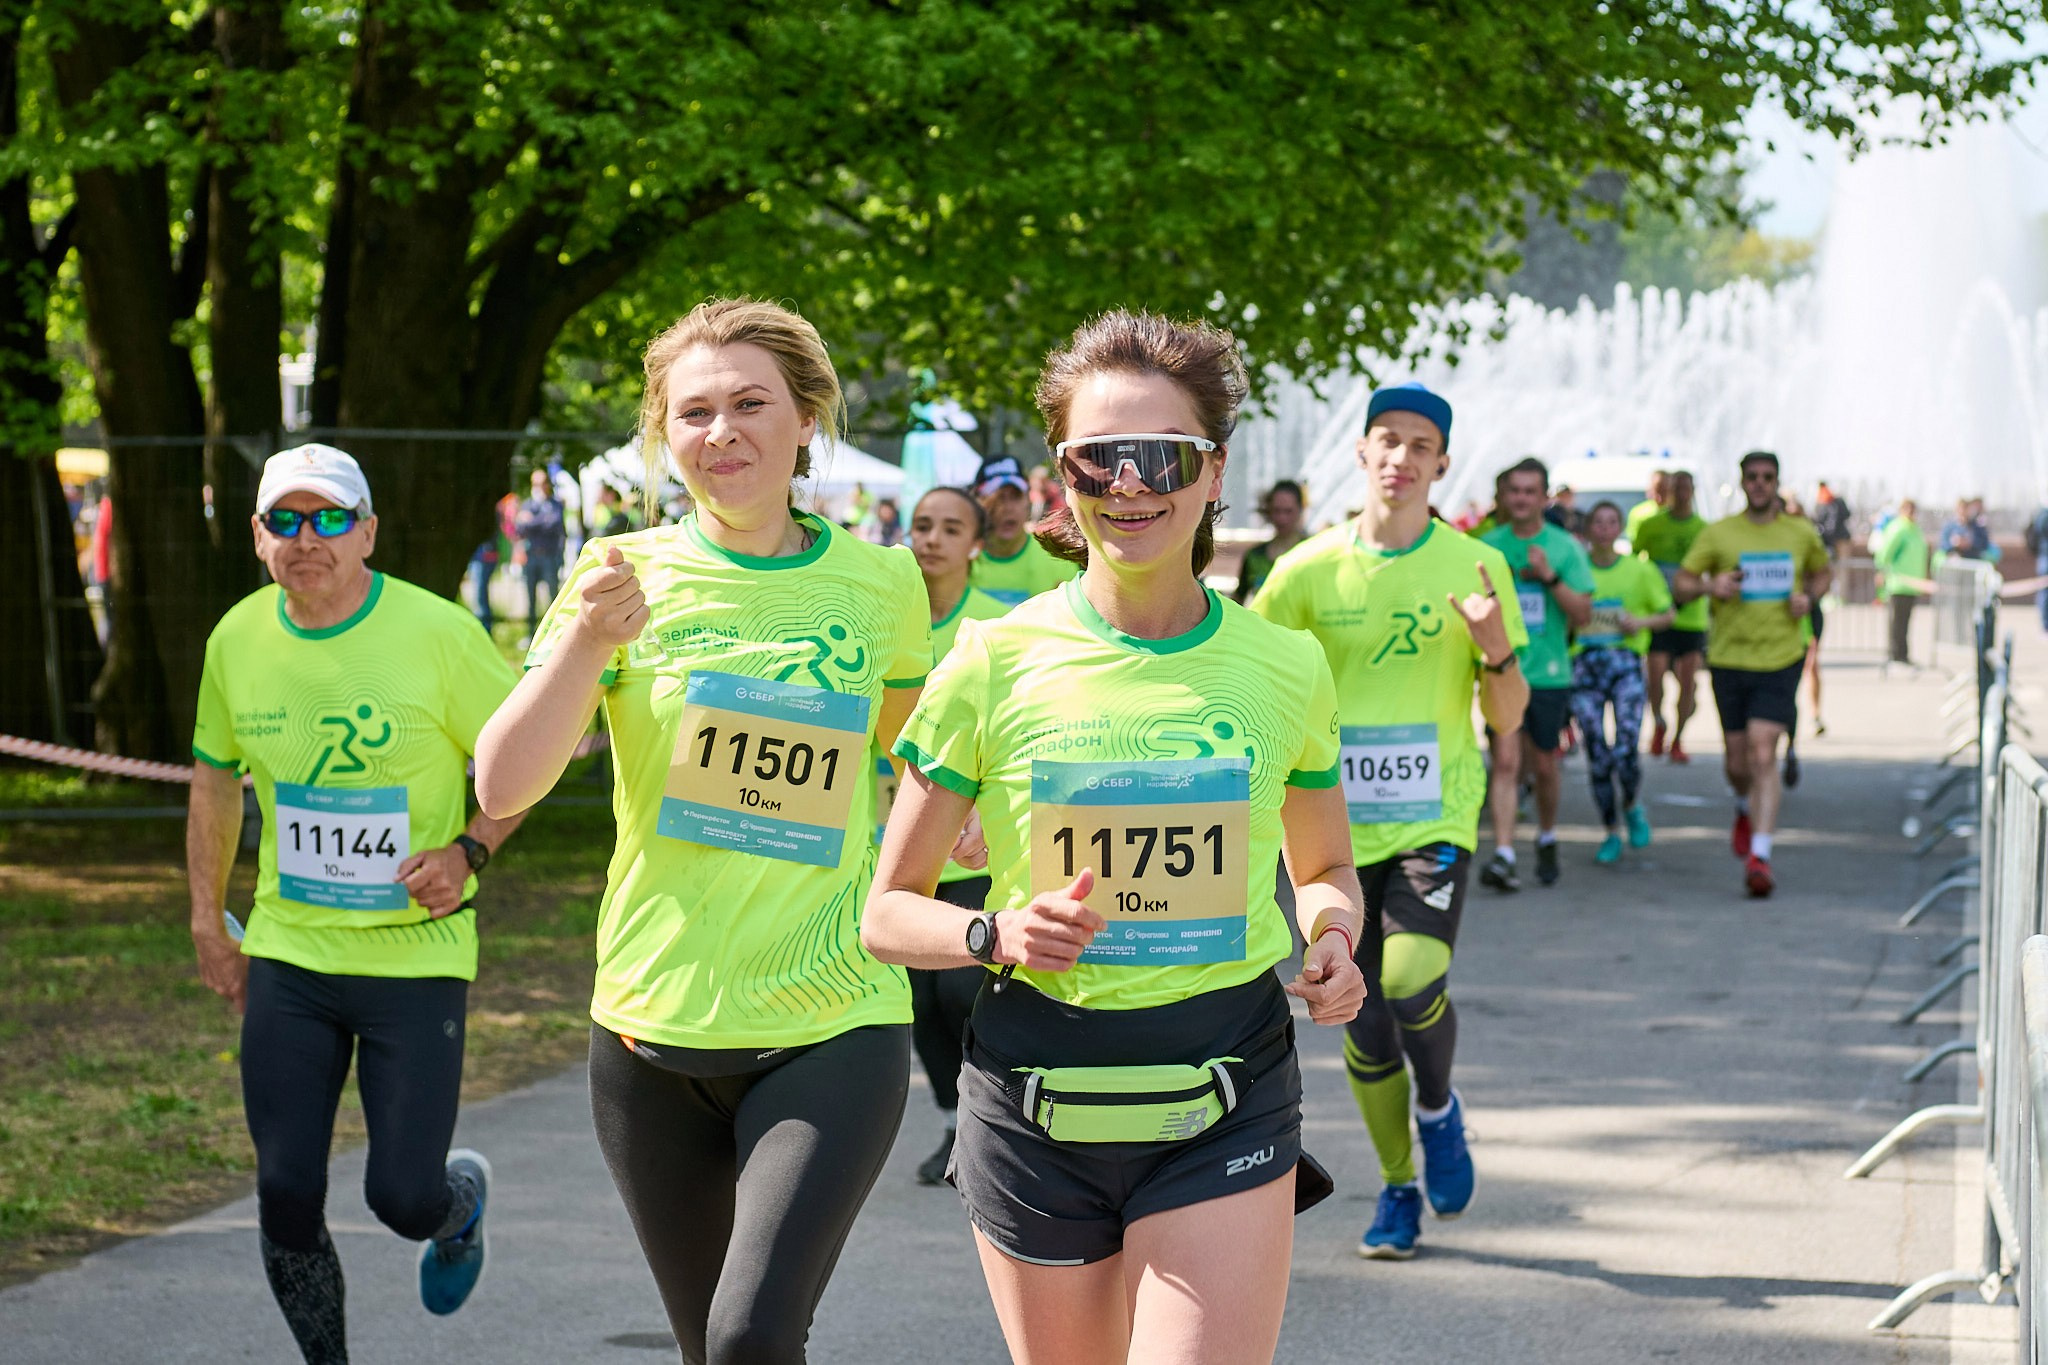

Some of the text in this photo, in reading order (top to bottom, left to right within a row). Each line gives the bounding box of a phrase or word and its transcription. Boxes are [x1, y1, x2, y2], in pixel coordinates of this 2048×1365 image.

[749, 691, 775, 702] СБЕР
[697, 726, 840, 791] 11501
[1343, 755, 1430, 781] 10659
[1102, 777, 1133, 788] СБЕР
[288, 822, 397, 858] 11144
[1053, 824, 1223, 879] 11751
[1226, 1144, 1275, 1177] 2XU
